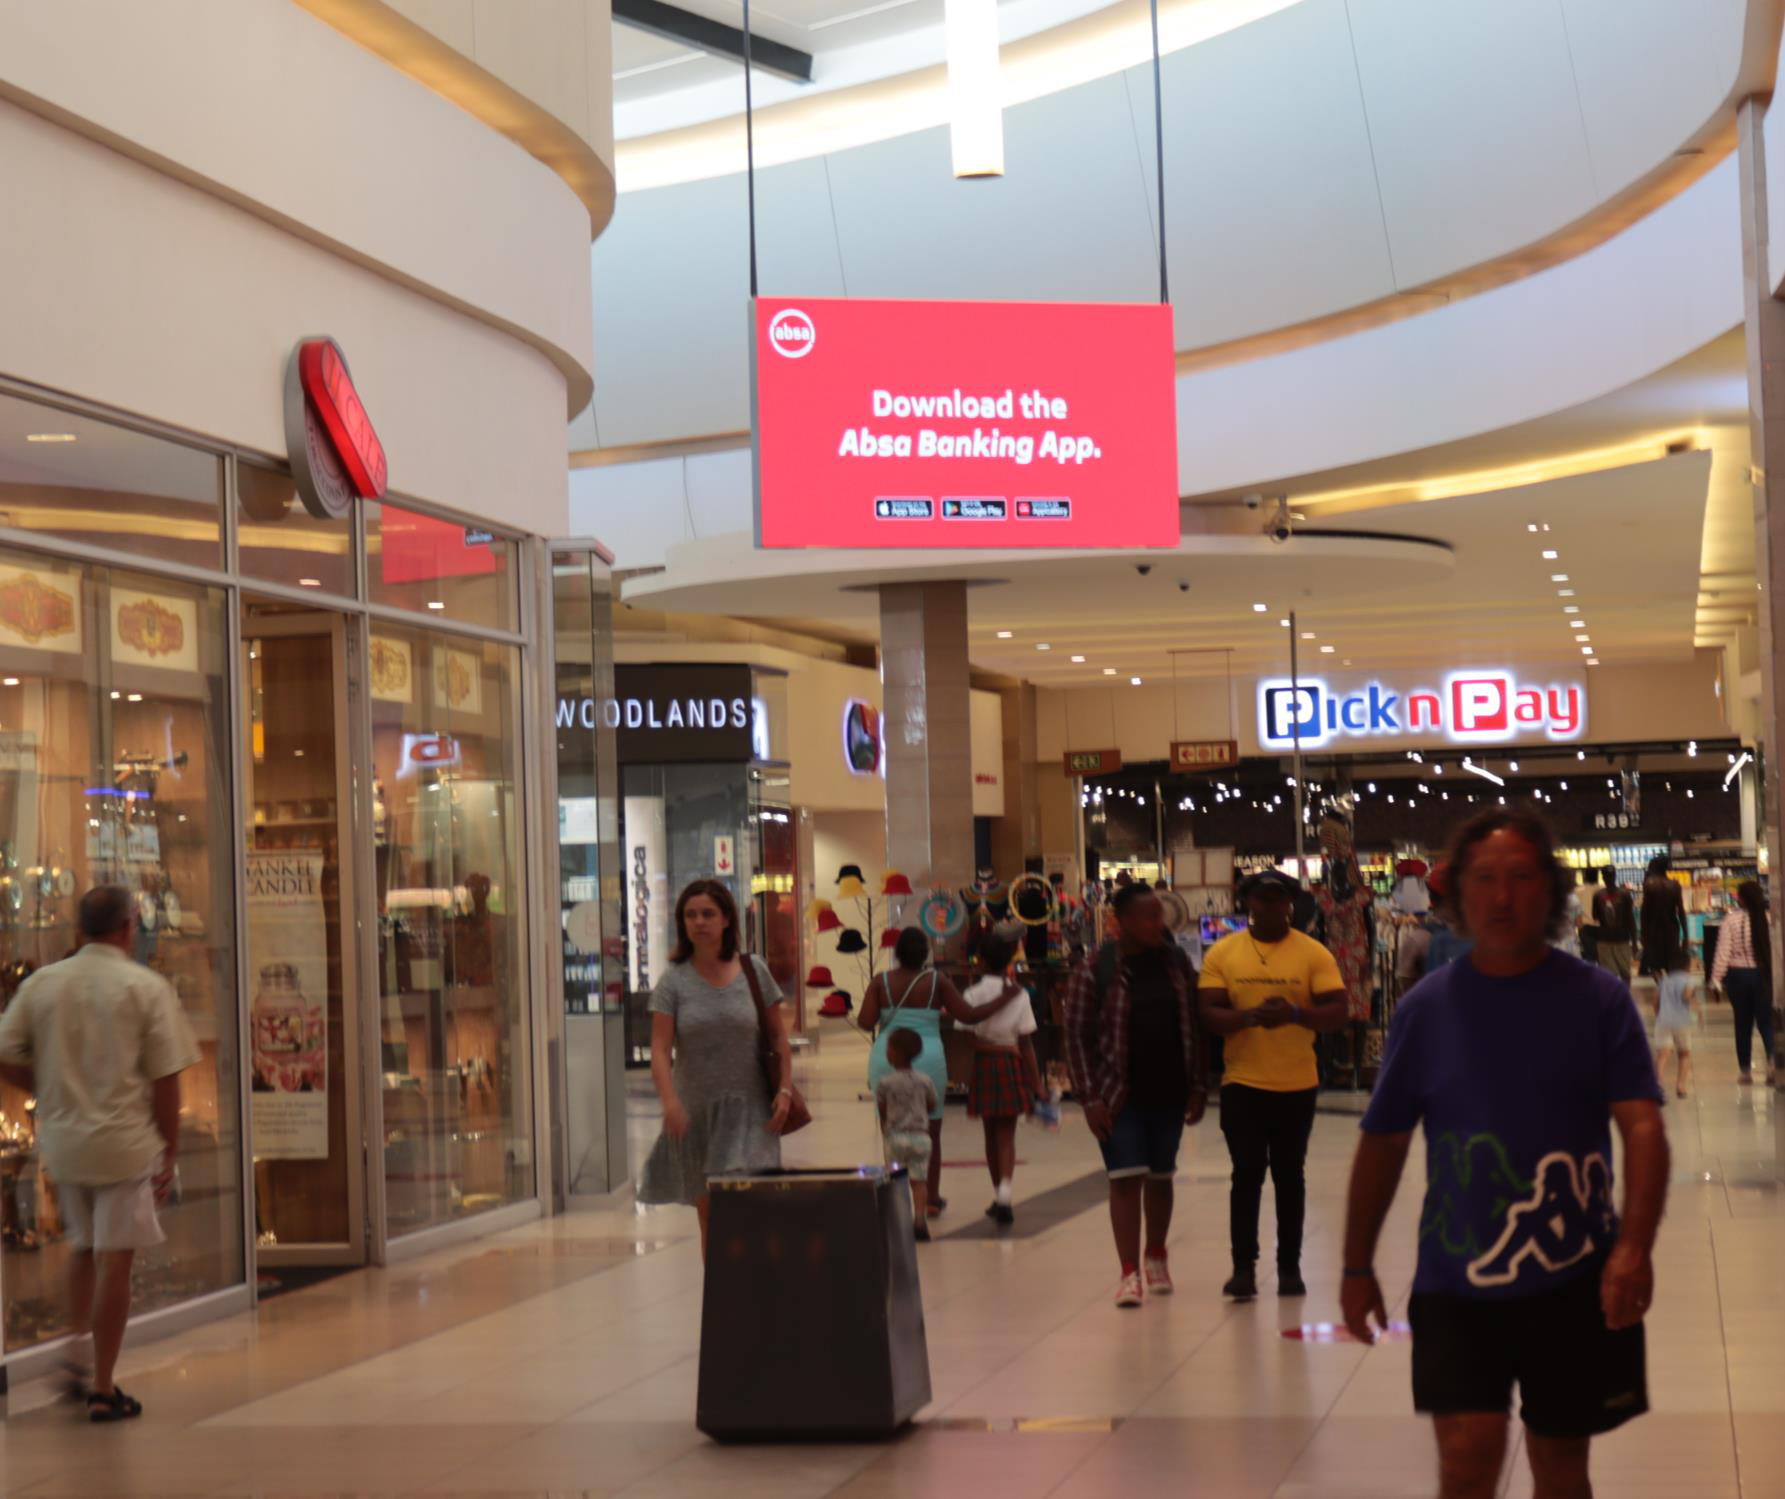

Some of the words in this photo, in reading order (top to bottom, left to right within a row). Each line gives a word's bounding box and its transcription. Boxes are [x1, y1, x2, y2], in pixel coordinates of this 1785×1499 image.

[775, 322, 811, 341] absa
[872, 389, 1013, 418] Download
[1019, 389, 1068, 419] the
[838, 426, 911, 457] Absa
[917, 428, 1034, 464] Banking
[1039, 430, 1101, 464] App.
[555, 698, 747, 728] WOODLANDS
[1407, 693, 1441, 727] n
[1451, 678, 1579, 733] Pay
